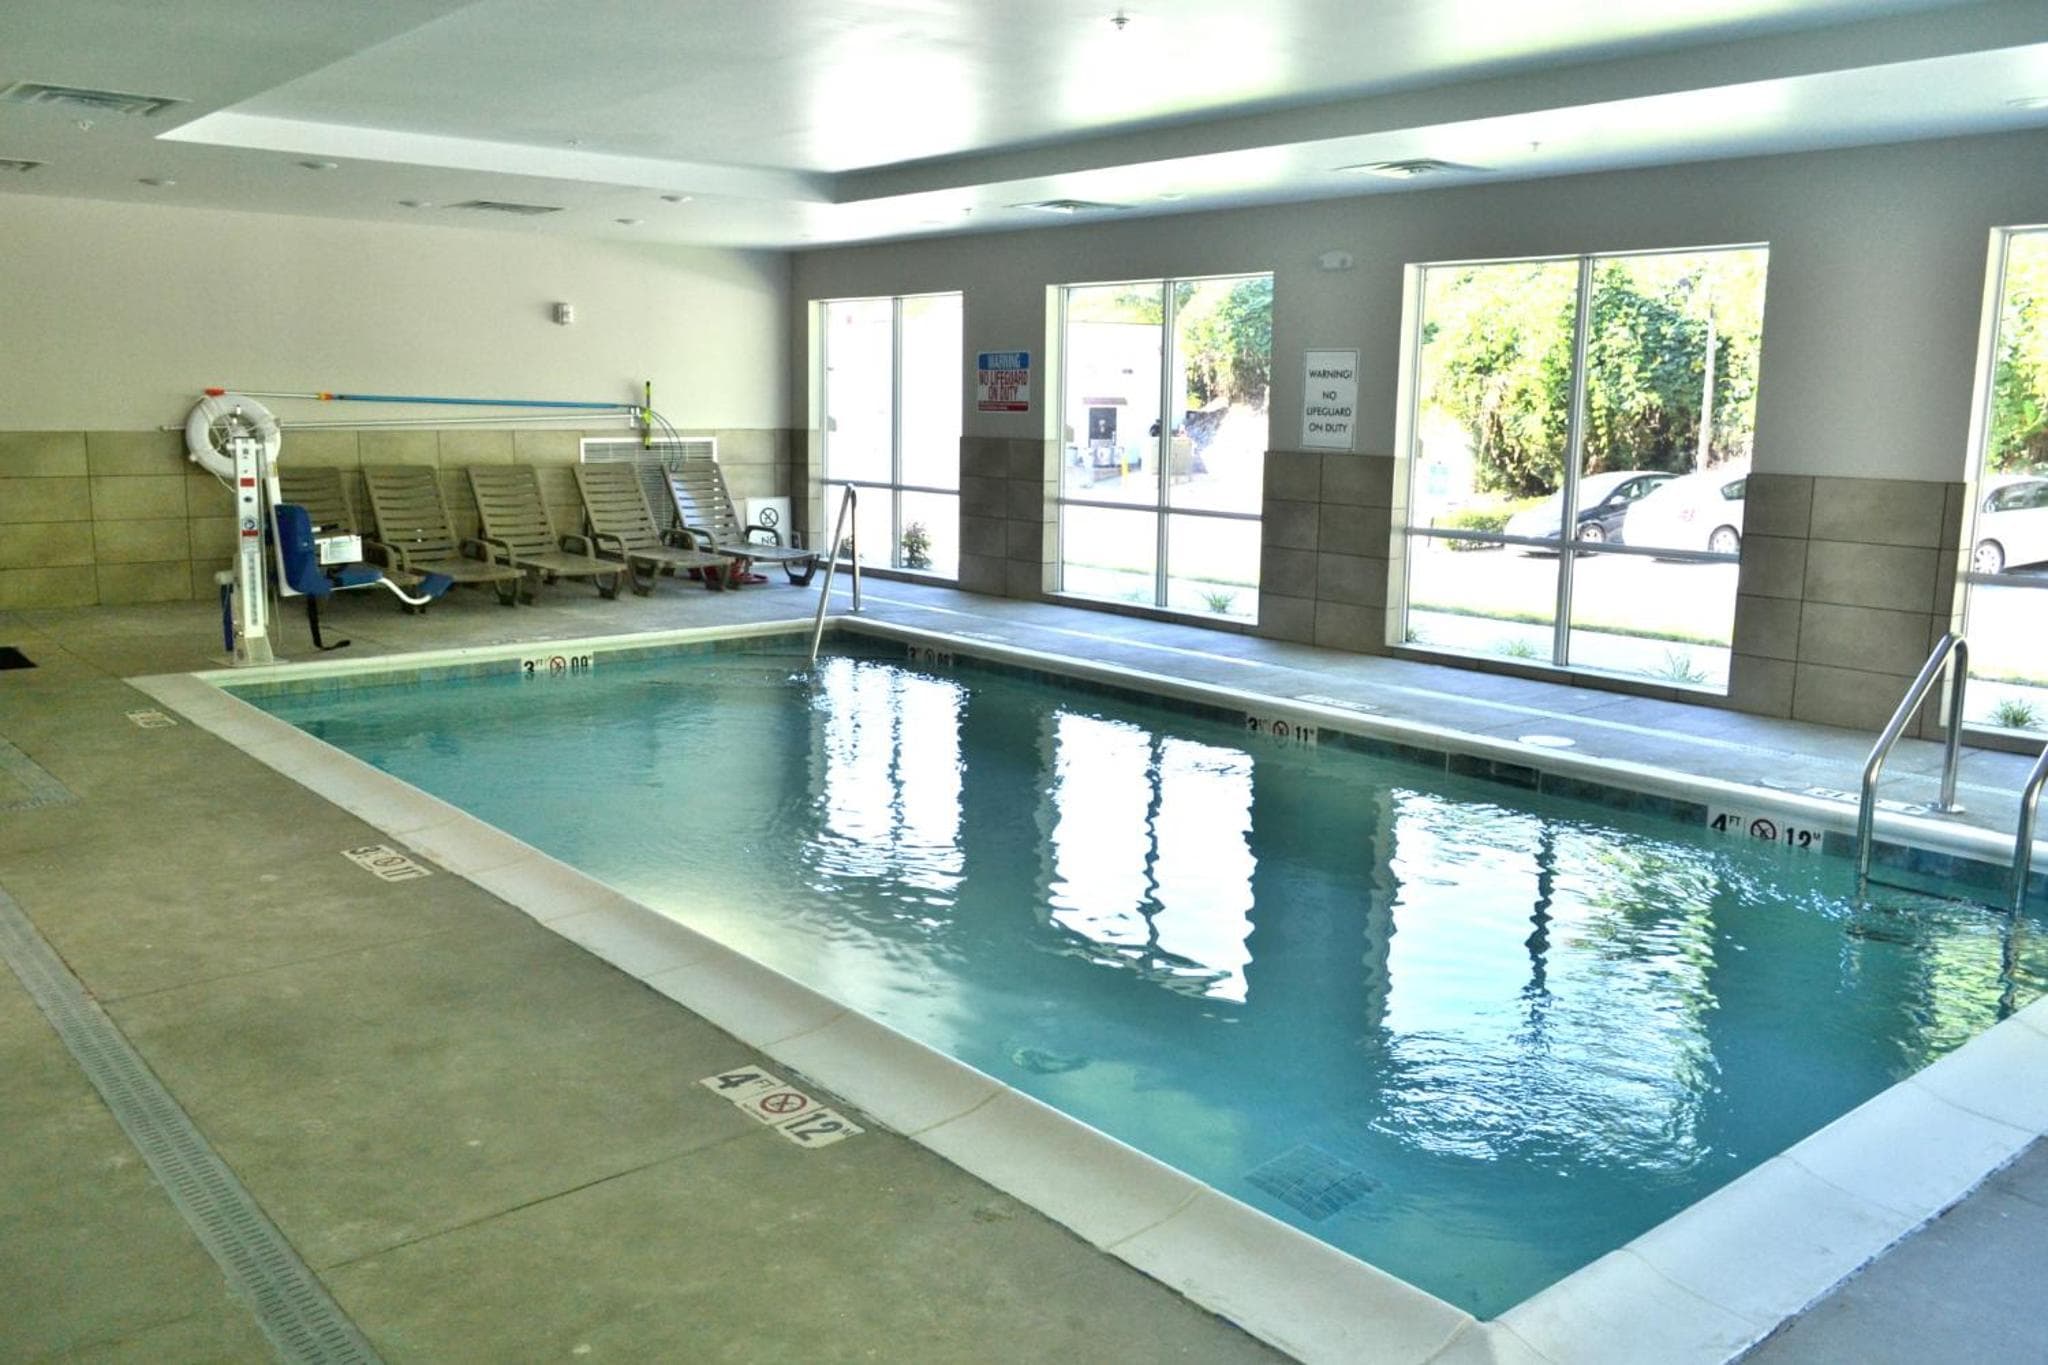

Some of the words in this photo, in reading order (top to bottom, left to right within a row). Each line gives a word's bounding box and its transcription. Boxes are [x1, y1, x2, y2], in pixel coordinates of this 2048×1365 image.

[1309, 368, 1353, 379] WARNING!
[1323, 390, 1337, 400] NO
[1306, 407, 1352, 416] LIFEGUARD
[1308, 422, 1322, 432] ON
[1325, 423, 1347, 432] DUTY
